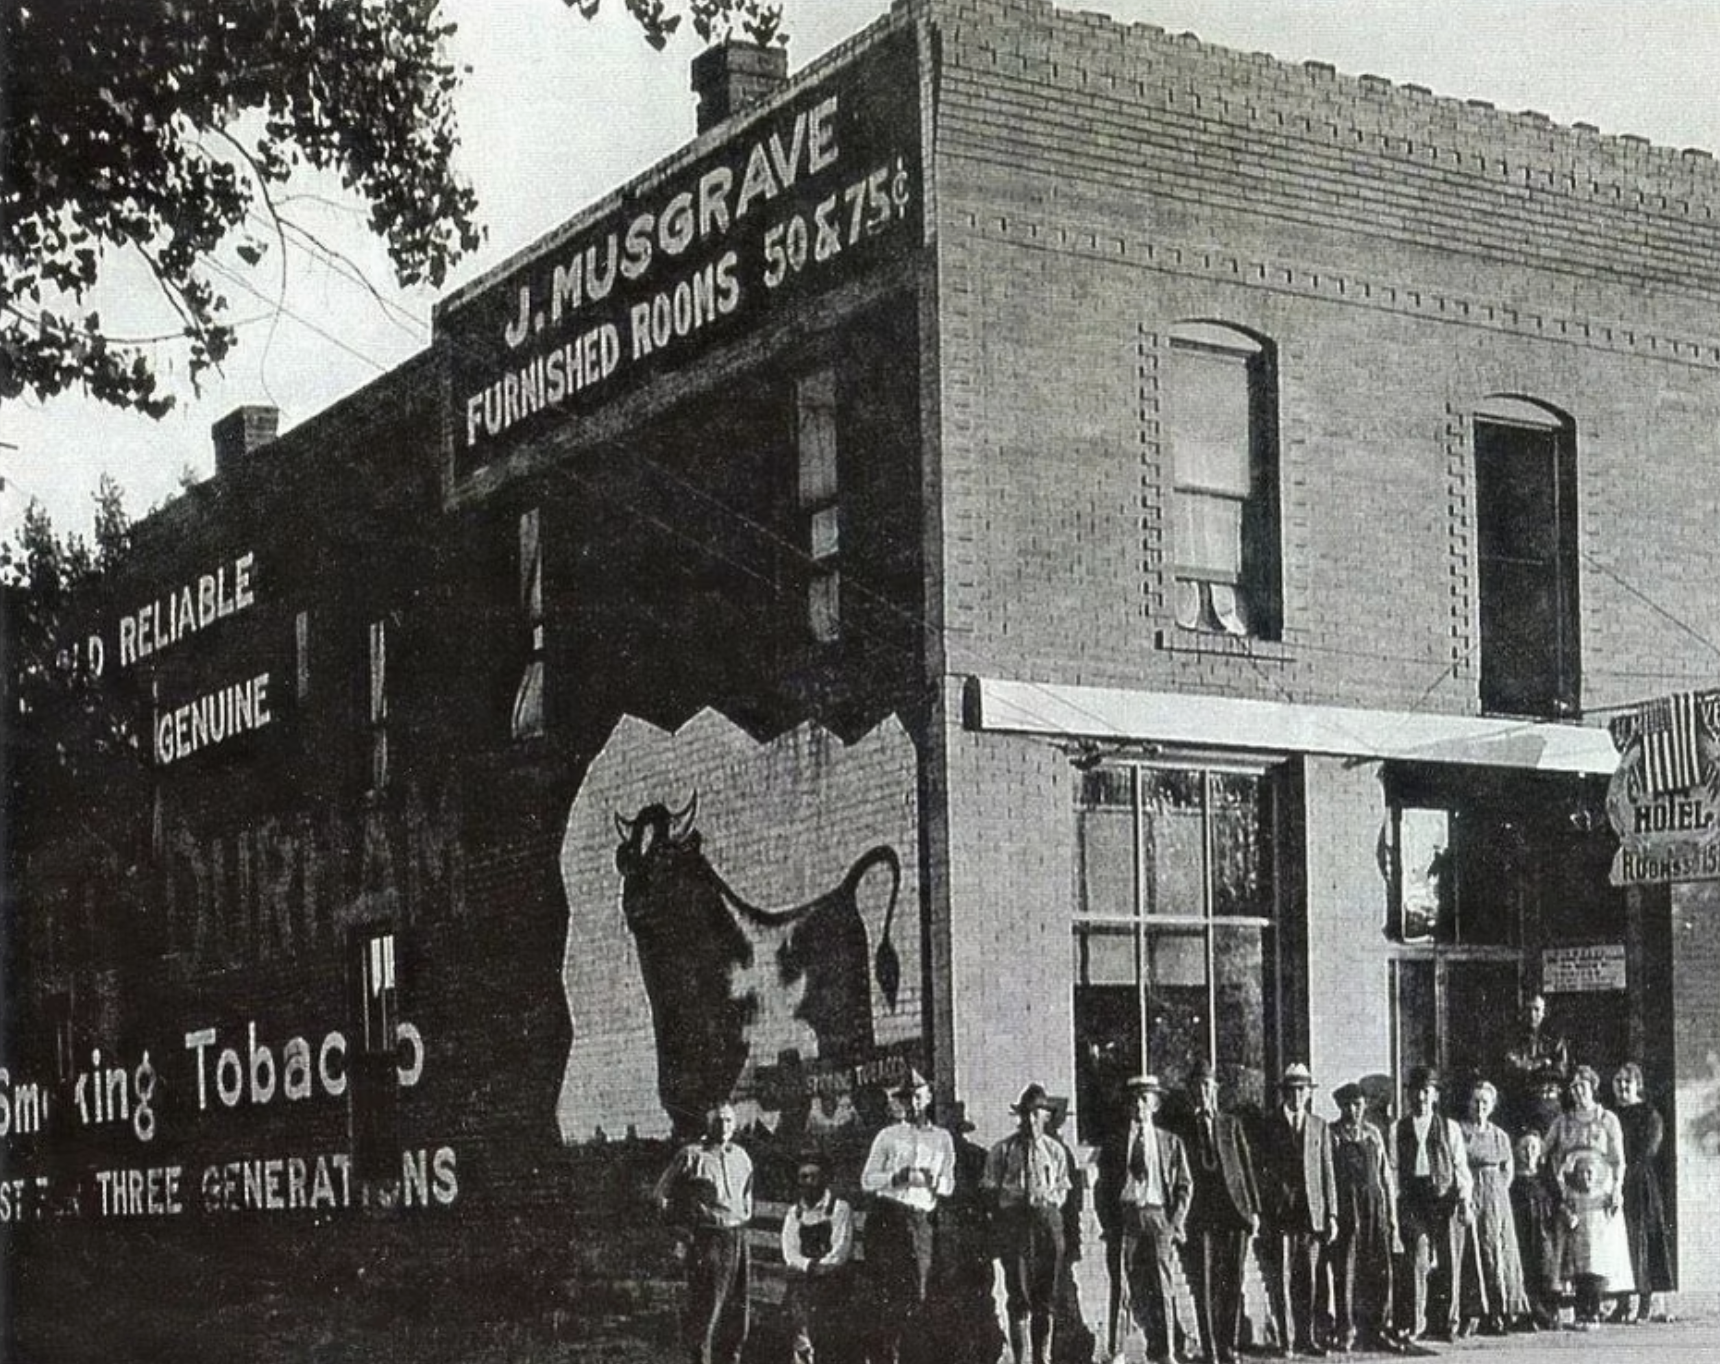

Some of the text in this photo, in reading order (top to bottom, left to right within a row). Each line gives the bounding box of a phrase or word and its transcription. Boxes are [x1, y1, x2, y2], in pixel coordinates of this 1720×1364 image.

[466, 322, 620, 446] FURNISHED
[630, 251, 739, 361] ROOMS
[119, 551, 254, 667] RELIABLE
[158, 673, 271, 763] GENUINE
[1634, 797, 1714, 833] HOTEL
[185, 1021, 424, 1109] Tobaco
[96, 1166, 182, 1216] THREE
